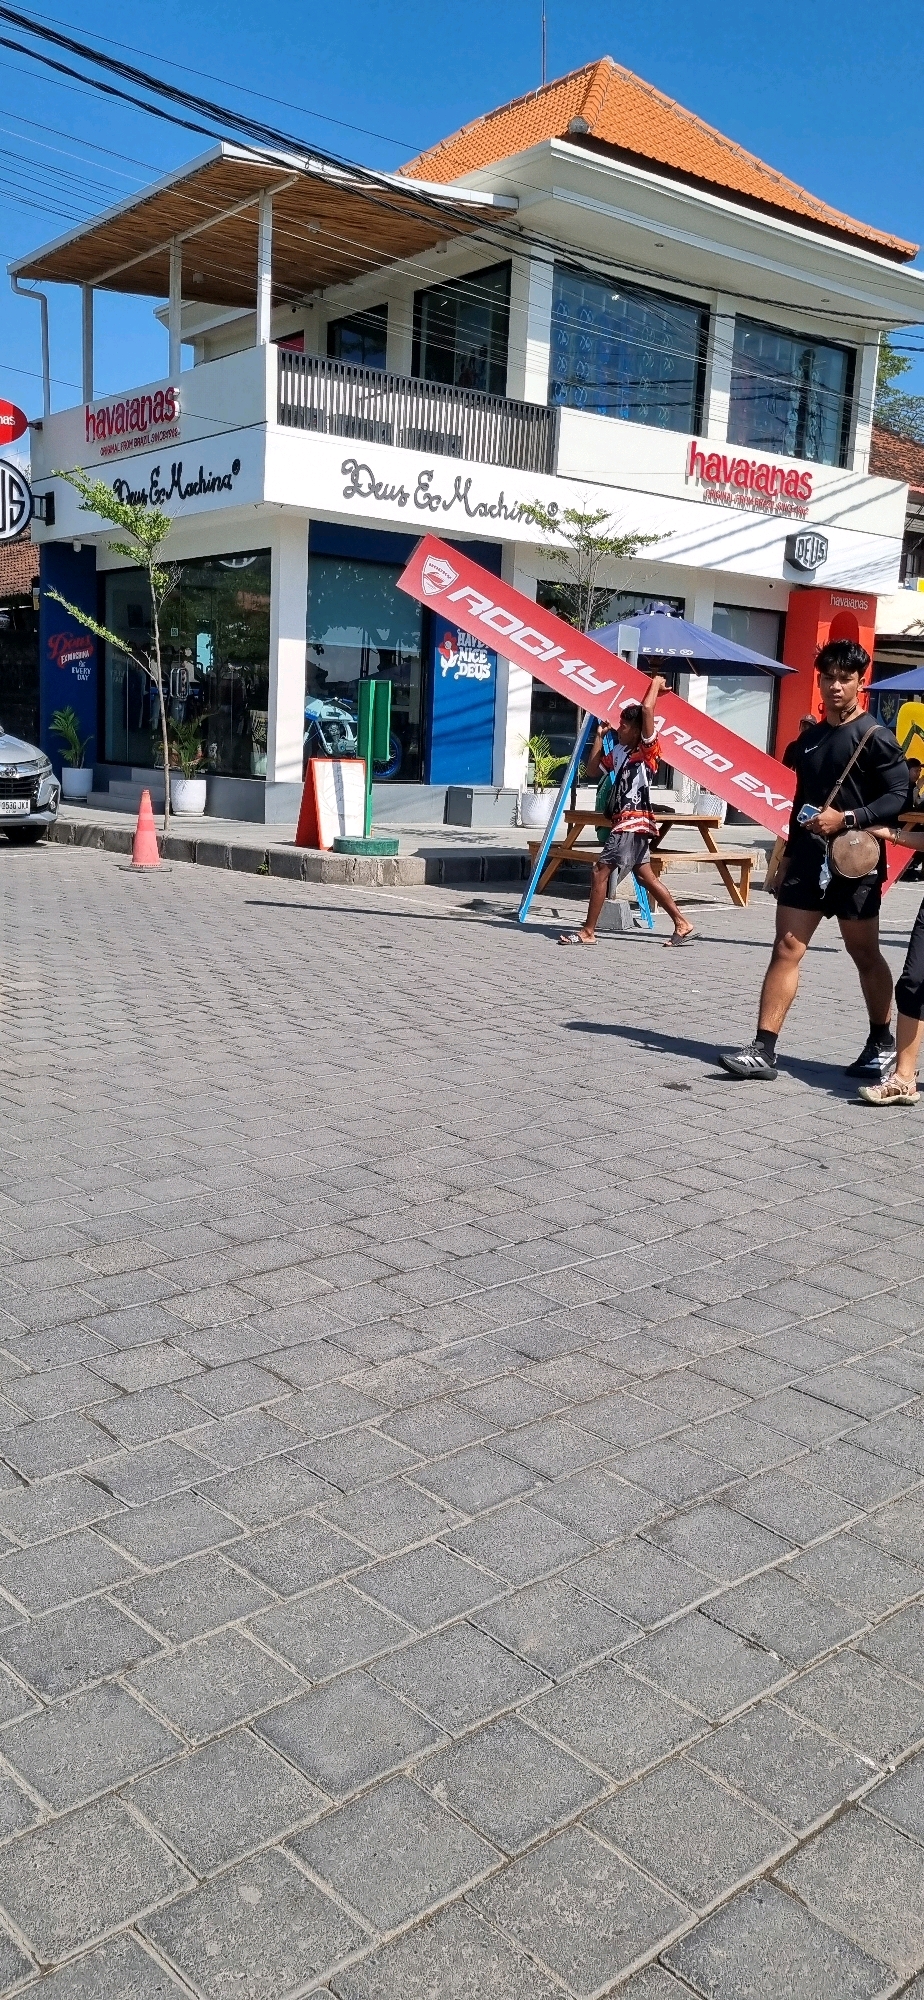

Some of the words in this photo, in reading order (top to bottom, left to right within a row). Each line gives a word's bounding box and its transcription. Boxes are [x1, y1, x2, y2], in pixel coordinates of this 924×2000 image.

[85, 386, 179, 442] havaianas
[341, 458, 411, 507] Deus
[686, 441, 813, 501] havaianas
[797, 536, 826, 566] DEUS
[830, 594, 869, 610] havaianas
[446, 586, 617, 695] ROCKY
[459, 647, 488, 663] NICE
[71, 666, 91, 675] EVERY
[454, 662, 491, 681] DEUS
